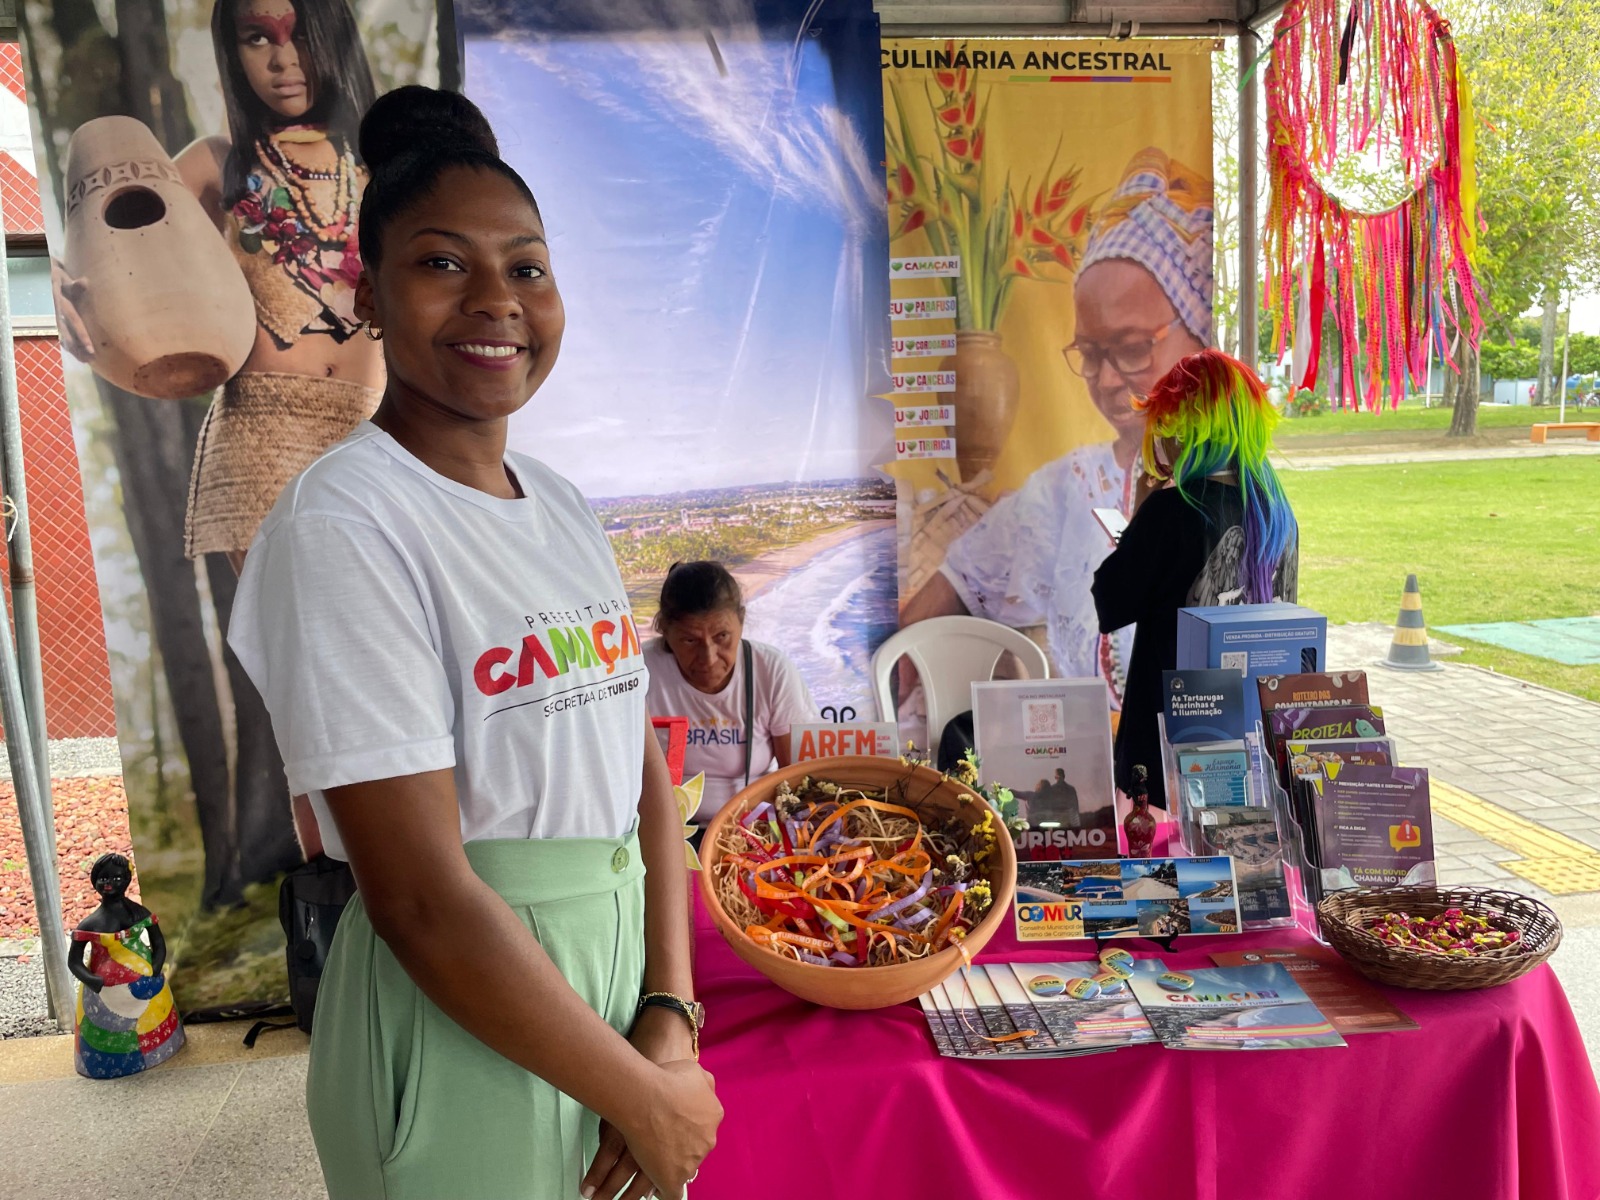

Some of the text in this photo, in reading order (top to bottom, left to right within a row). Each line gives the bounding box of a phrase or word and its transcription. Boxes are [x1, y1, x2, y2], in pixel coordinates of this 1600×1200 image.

[881, 45, 1172, 71] CULINÁRIA ANCESTRAL
[904, 261, 958, 271] CAMAÇARI
[915, 300, 956, 313] PARAFUSO
[917, 374, 955, 386] CANCELAS
[919, 407, 949, 421] JORDÃO
[918, 440, 951, 452] TIRIRICA
[524, 599, 629, 629] PREFEITURA
[473, 614, 641, 697] CAMAÇA
[1182, 694, 1224, 702] Tartarugas
[1292, 690, 1331, 701] ROTEIRO DAS
[1172, 701, 1209, 709] Marinhas
[1179, 708, 1222, 717] Iluminação
[1292, 721, 1353, 740] PROTEJA
[687, 729, 747, 746] BRASIL
[1025, 746, 1067, 755] CAMAÇARI
[1014, 828, 1106, 849] URISMO
[1383, 867, 1407, 876] DÚVID
[1353, 874, 1383, 882] CHAMA
[1018, 904, 1083, 922] COMTUR
[1047, 923, 1075, 932] Municipal
[1053, 930, 1082, 938] Camaçari
[1166, 990, 1280, 1003] CAMAÇARI
